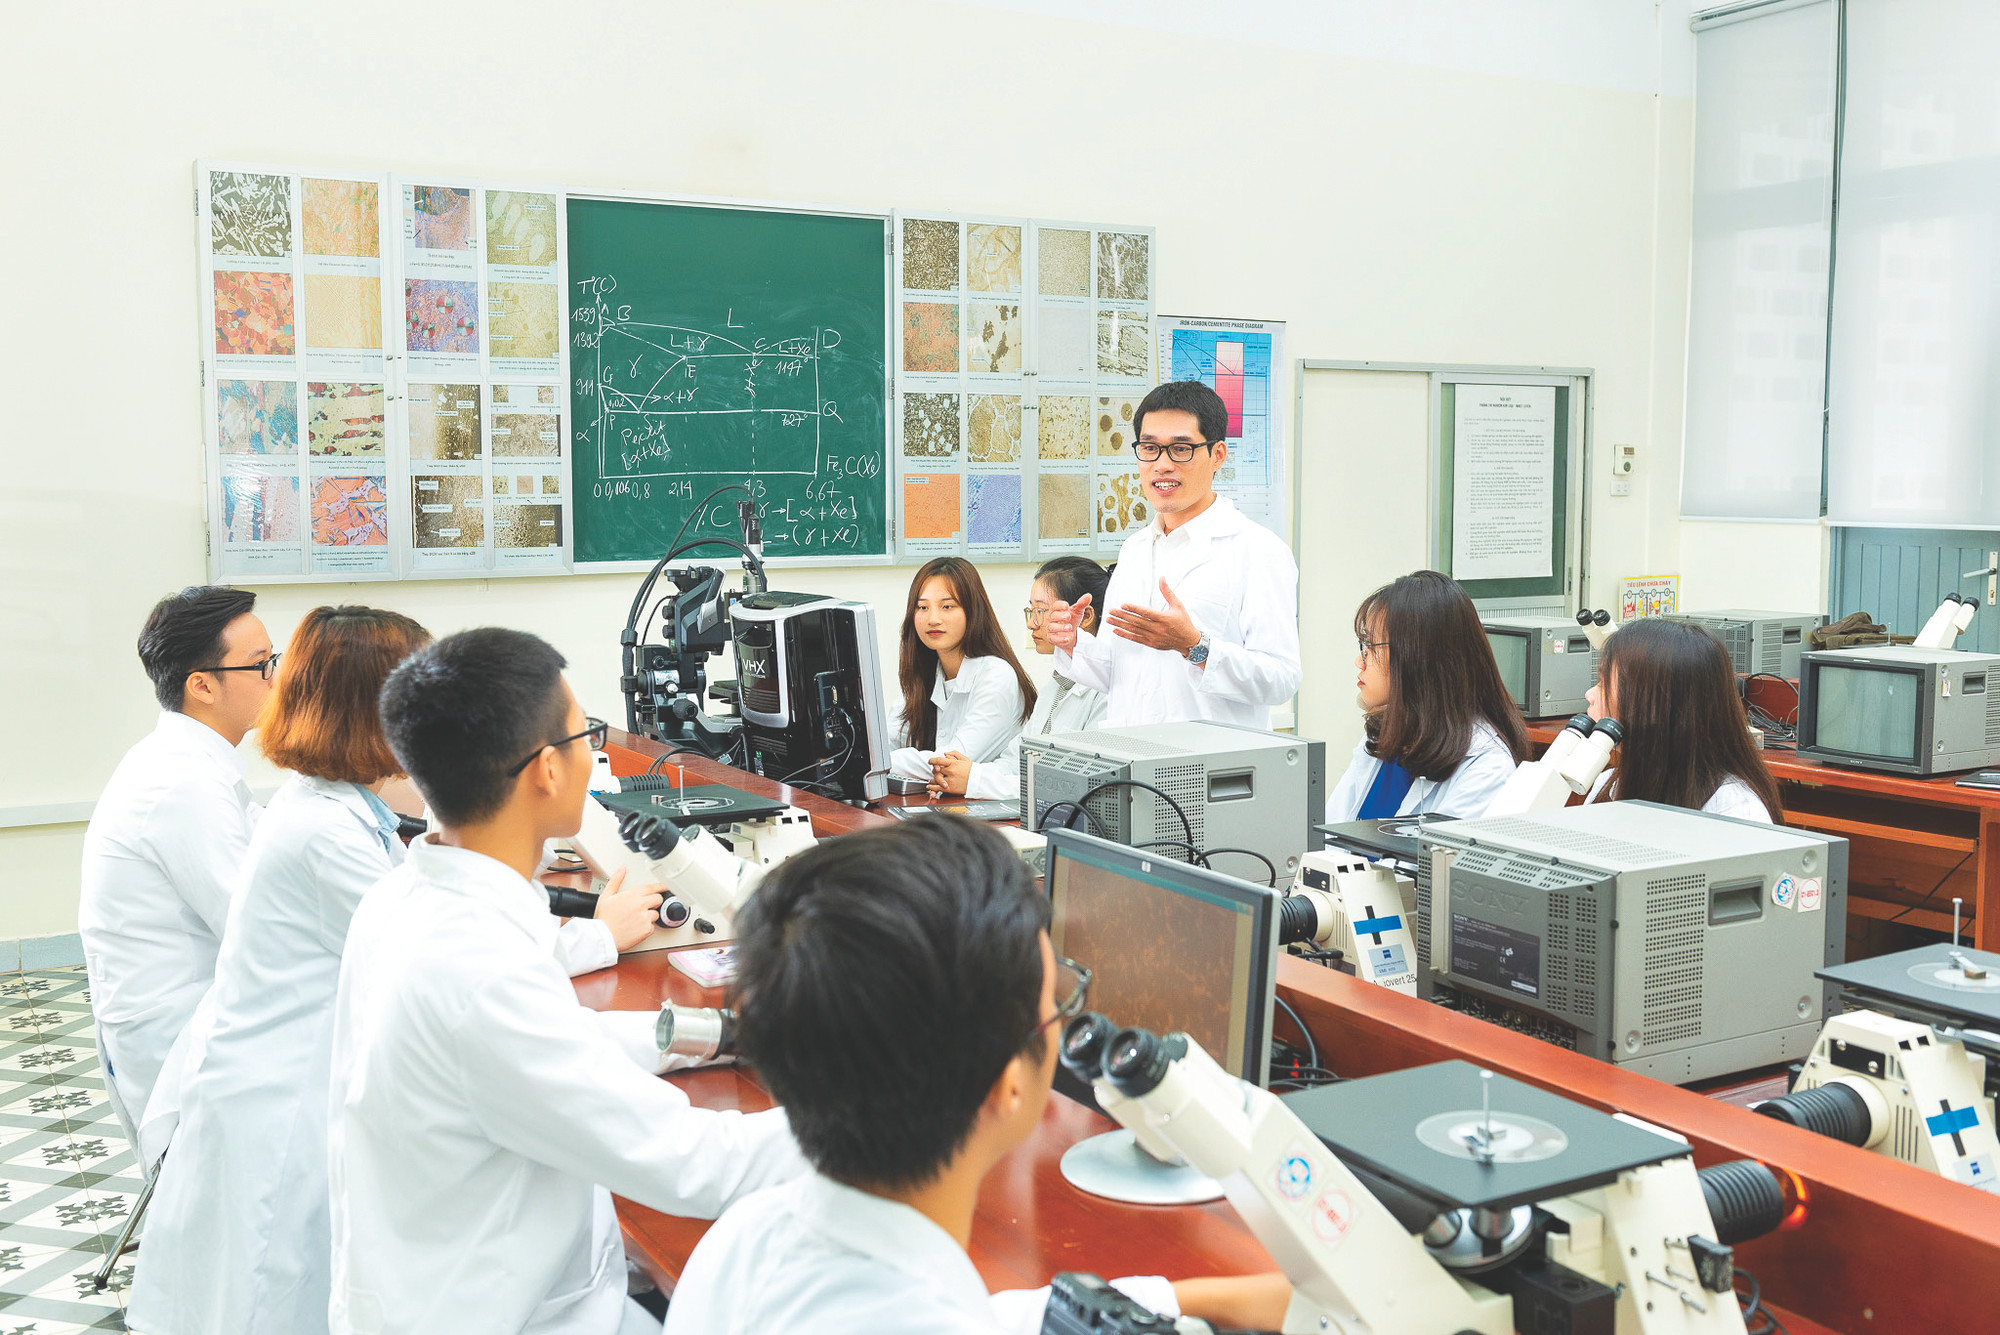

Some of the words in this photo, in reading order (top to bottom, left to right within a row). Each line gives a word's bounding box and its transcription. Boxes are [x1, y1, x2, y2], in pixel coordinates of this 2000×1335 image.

[571, 307, 596, 325] 1539
[617, 305, 632, 321] B
[727, 308, 745, 328] L
[823, 328, 842, 349] D
[576, 379, 594, 397] 911
[609, 414, 616, 430] P
[823, 401, 844, 424] Q
[632, 481, 651, 501] 0,8
[805, 480, 843, 502] 6,67
[742, 658, 766, 675] VHX
[1451, 879, 1529, 916] SONY
